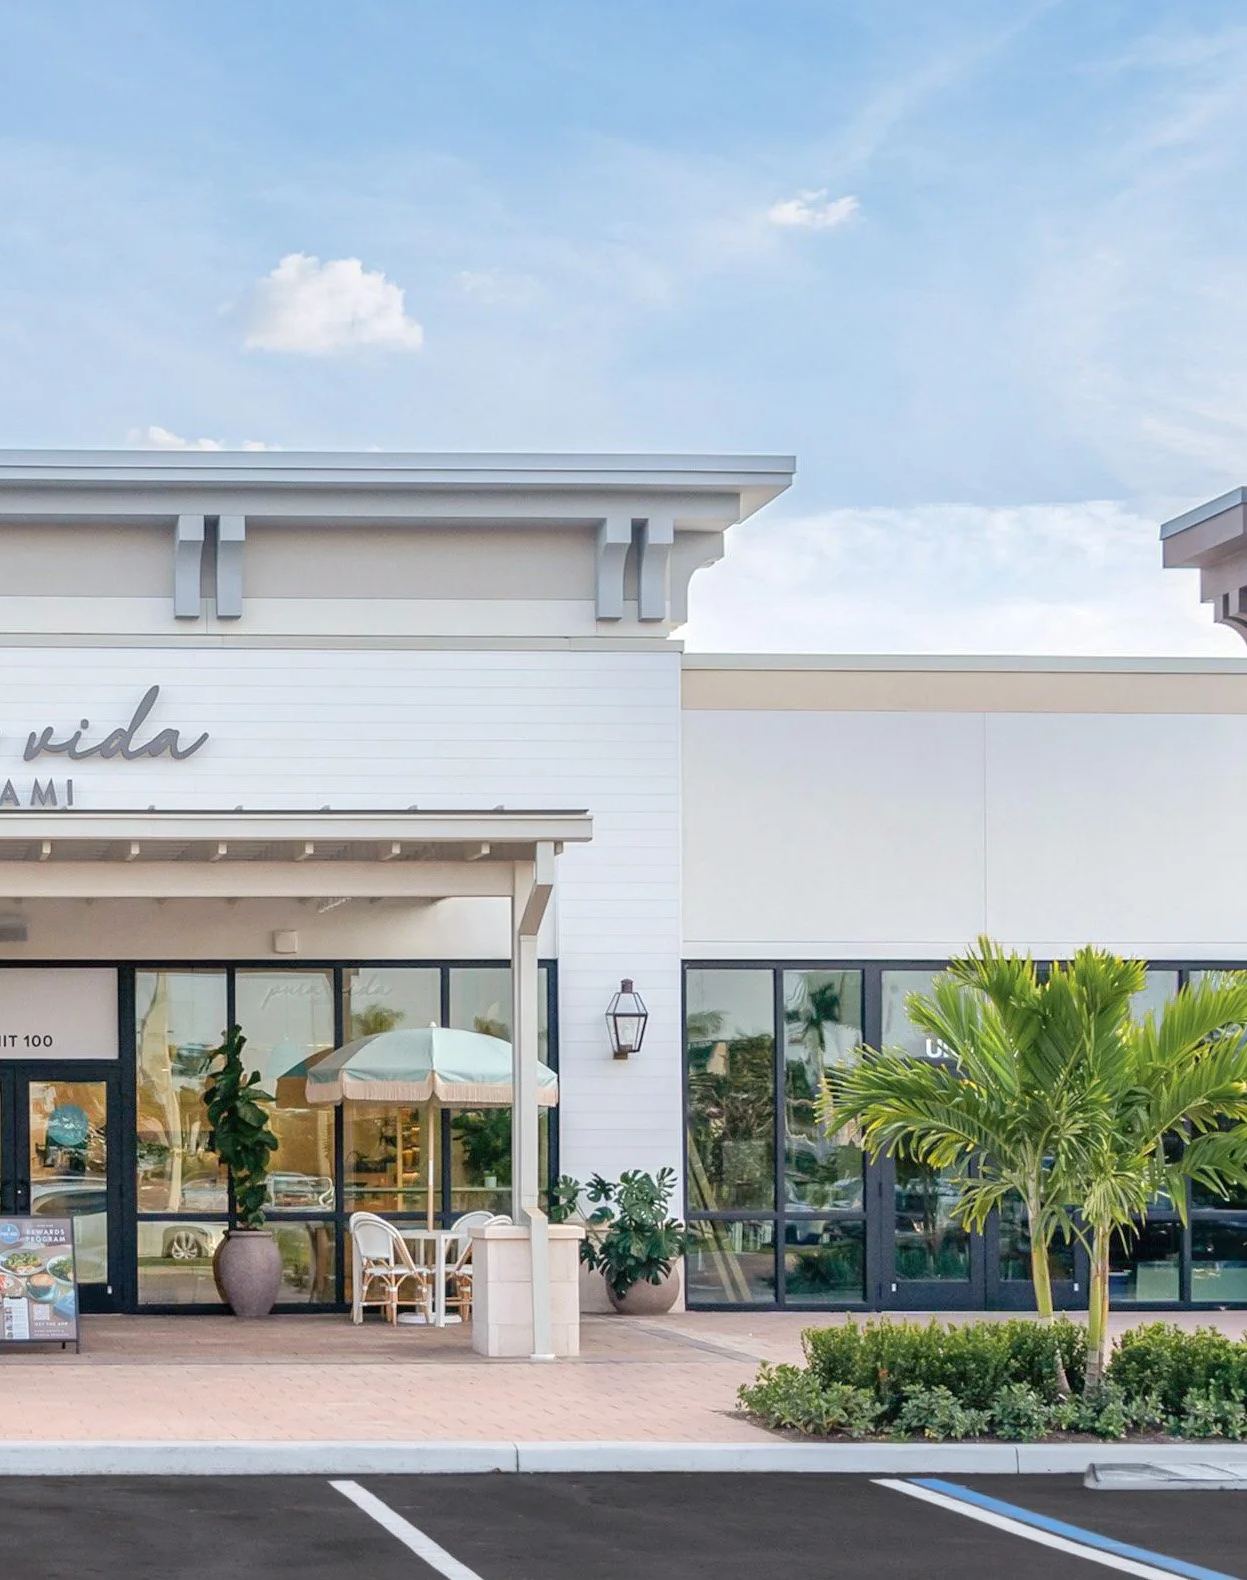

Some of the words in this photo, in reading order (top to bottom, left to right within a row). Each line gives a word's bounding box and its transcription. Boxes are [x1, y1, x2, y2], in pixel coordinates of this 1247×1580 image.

[23, 685, 209, 761] vida
[23, 1035, 53, 1048] 100
[26, 1228, 65, 1236] REWARDS
